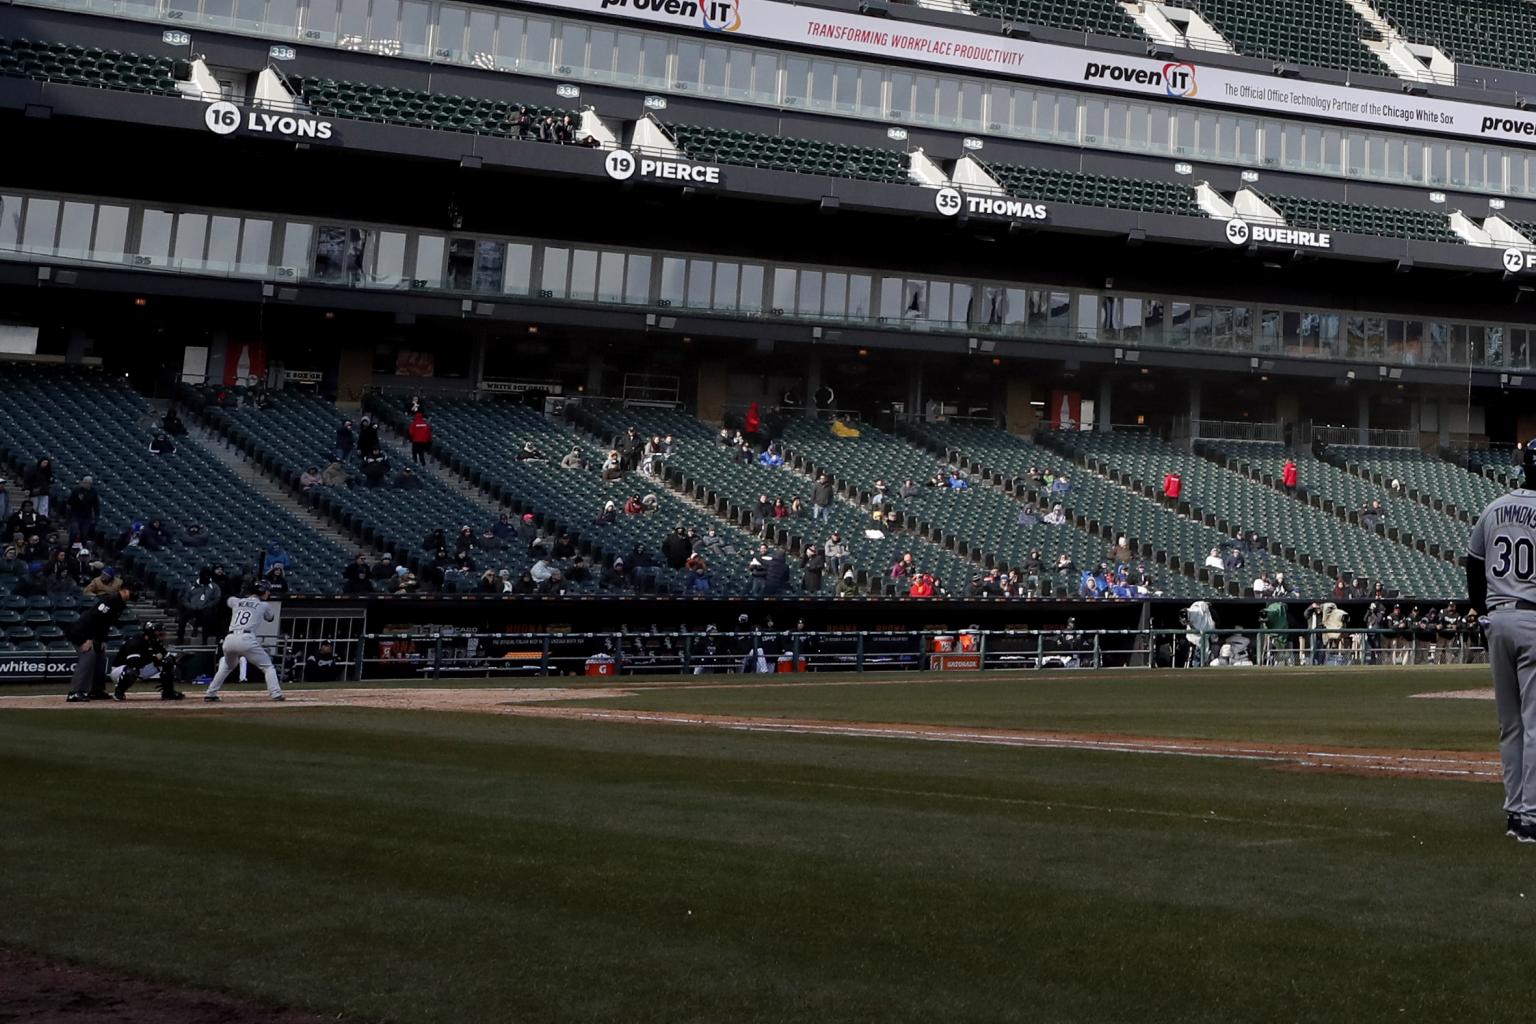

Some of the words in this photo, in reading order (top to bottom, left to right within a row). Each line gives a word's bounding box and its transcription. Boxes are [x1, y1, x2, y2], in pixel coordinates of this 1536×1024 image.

[709, 2, 731, 22] IT
[165, 32, 188, 44] 336
[807, 21, 888, 46] TRANSFORMING
[891, 33, 952, 56] WORKPLACE
[953, 43, 1025, 66] PRODUCTIVITY
[271, 47, 294, 59] 338
[1084, 61, 1162, 86] proven
[1172, 72, 1189, 89] IT
[558, 85, 578, 97] 338
[646, 97, 666, 108] 340
[1224, 82, 1239, 96] The
[1240, 84, 1266, 99] Official
[1267, 89, 1289, 104] Office
[1290, 92, 1332, 112] Technology
[1332, 98, 1359, 113] Partner
[1360, 102, 1369, 114] of
[1369, 103, 1382, 116] the
[1382, 105, 1414, 121] Chicago
[1416, 109, 1439, 123] White
[1440, 113, 1454, 125] Sox
[212, 109, 235, 127] 16
[247, 112, 333, 139] LYONS
[888, 129, 906, 139] 340
[966, 139, 982, 148] 342
[610, 157, 631, 172] 19
[640, 159, 720, 183] PIERCE
[1176, 164, 1192, 174] 342
[939, 194, 959, 208] 35
[966, 196, 1047, 219] THOMAS
[1229, 224, 1247, 238] 56
[1252, 226, 1330, 248] BUEHRLE
[1505, 254, 1521, 266] 72
[1491, 534, 1536, 581] 30
[235, 610, 251, 626] 18
